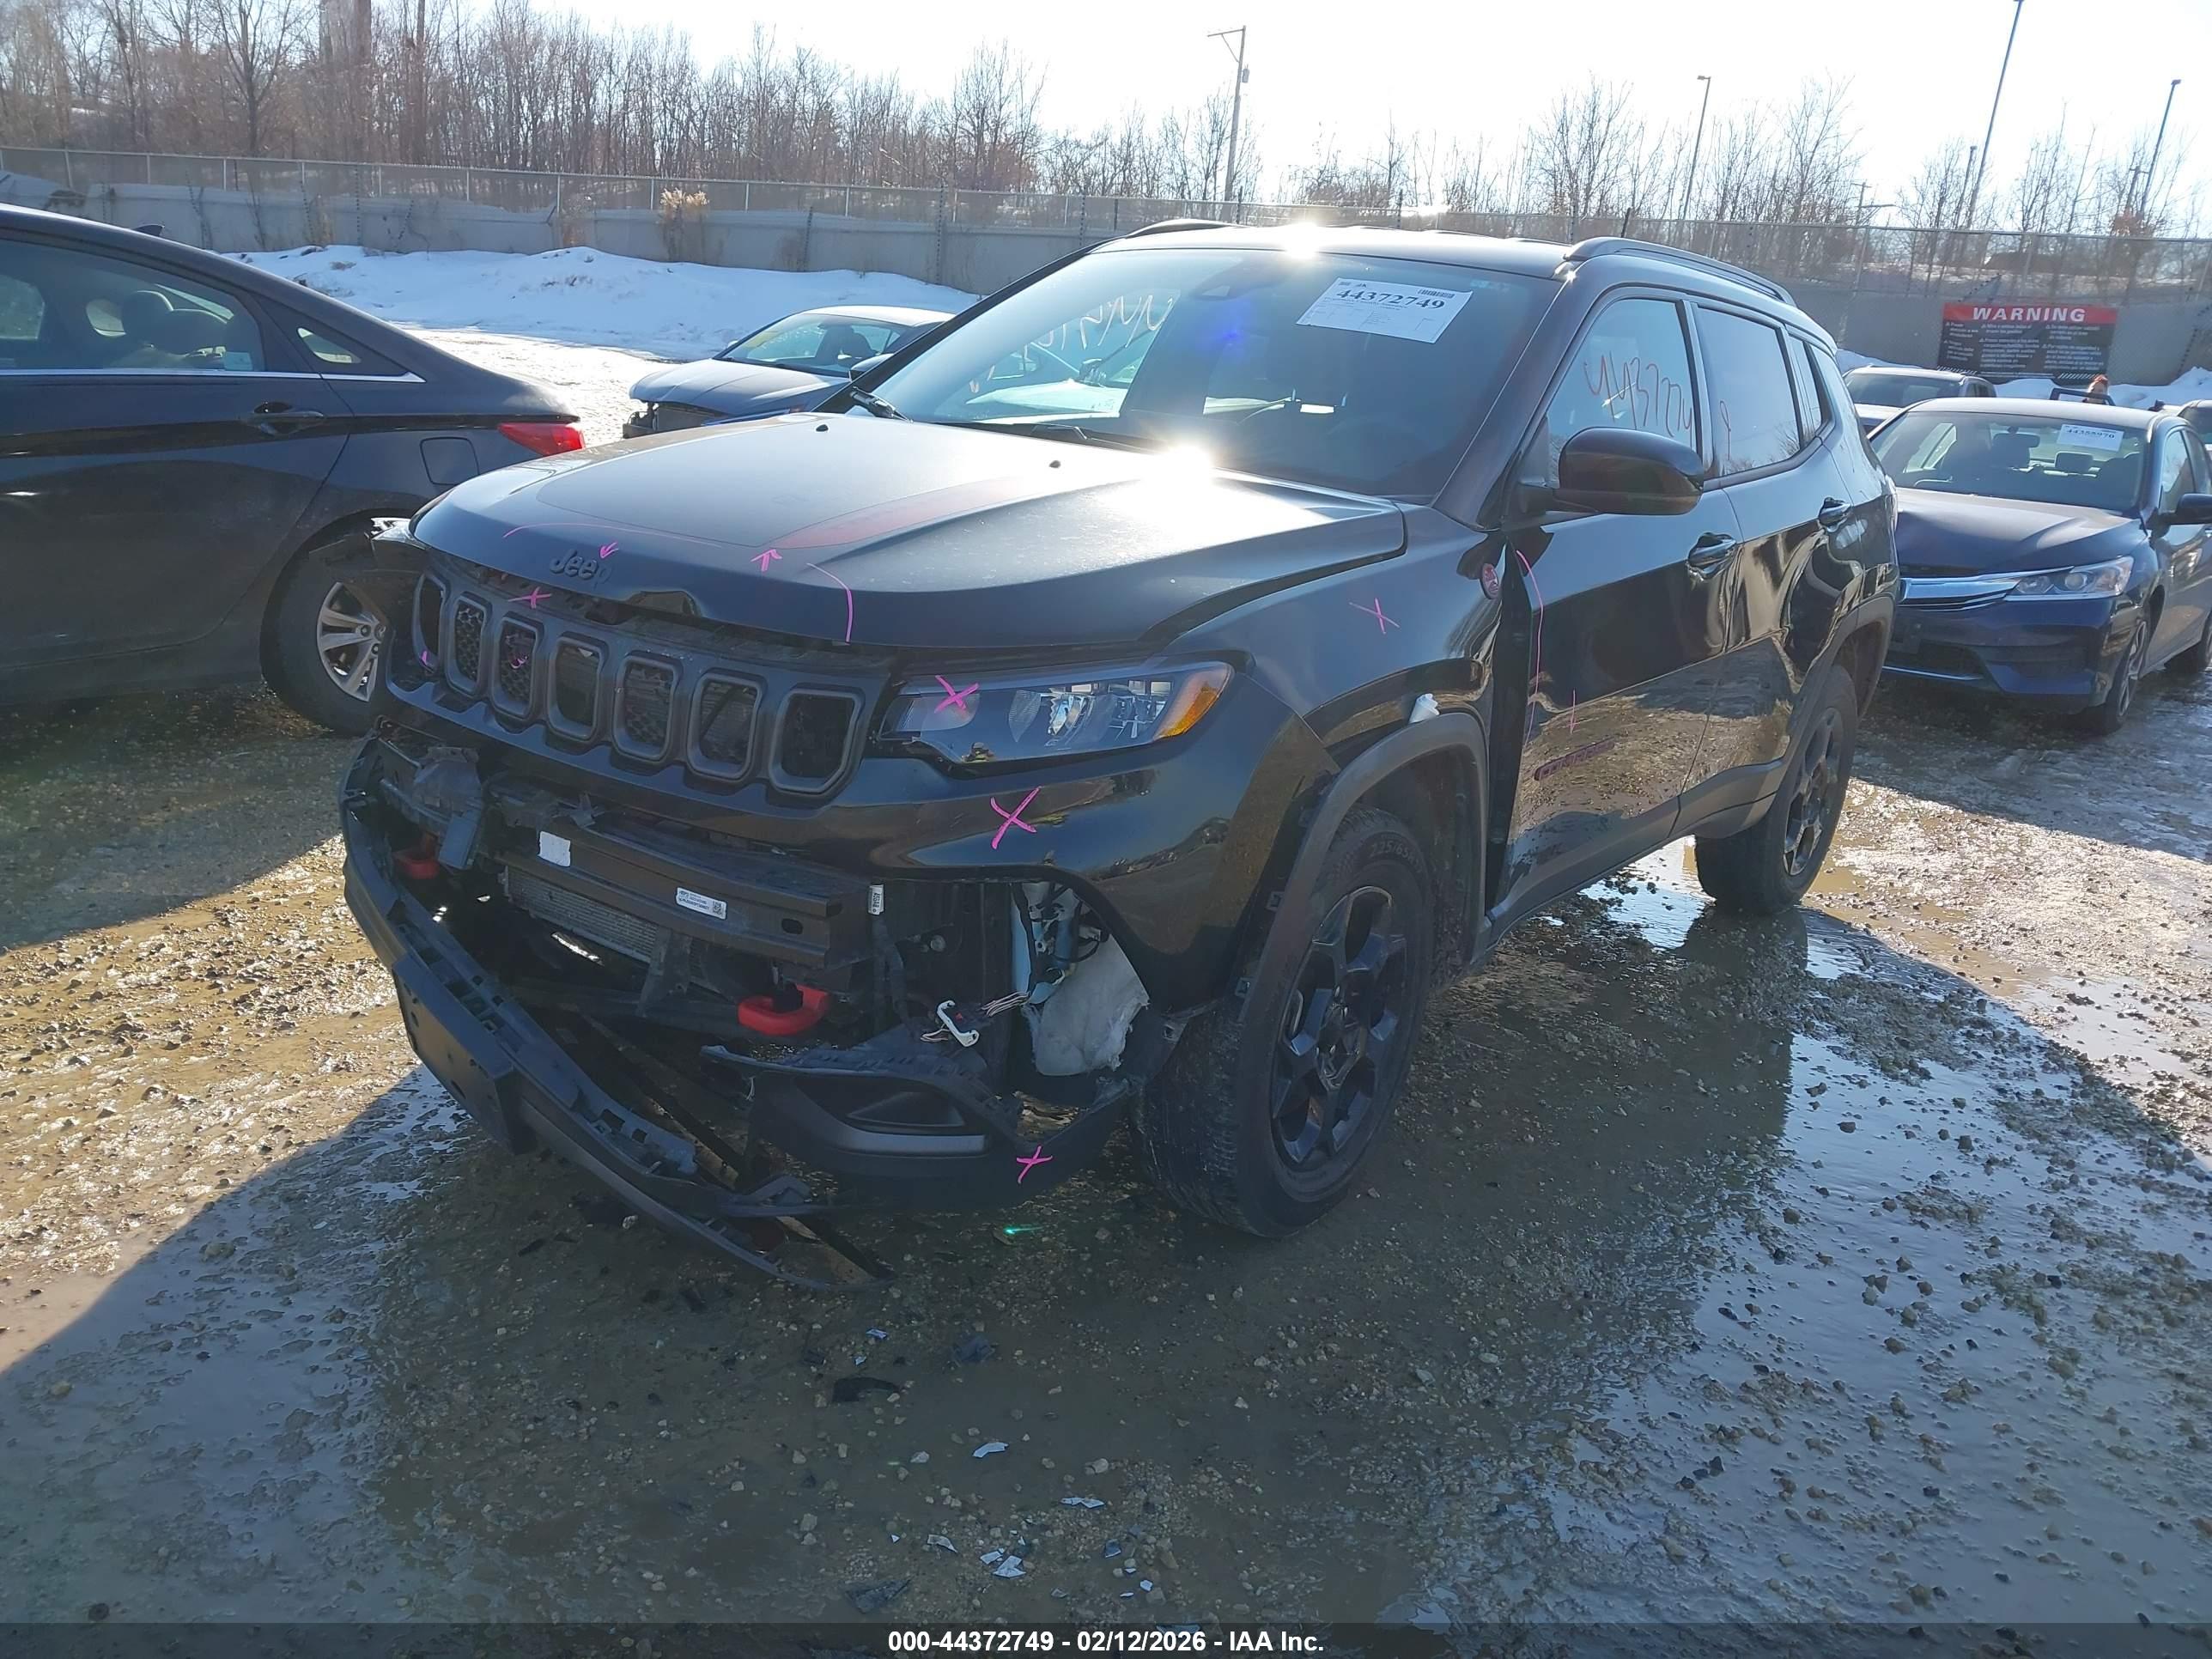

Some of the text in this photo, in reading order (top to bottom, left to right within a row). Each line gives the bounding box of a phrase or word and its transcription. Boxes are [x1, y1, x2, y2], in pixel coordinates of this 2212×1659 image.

[1336, 289, 1445, 309] 44372749
[1972, 307, 2086, 322] WARNING
[550, 549, 612, 590] Jeep
